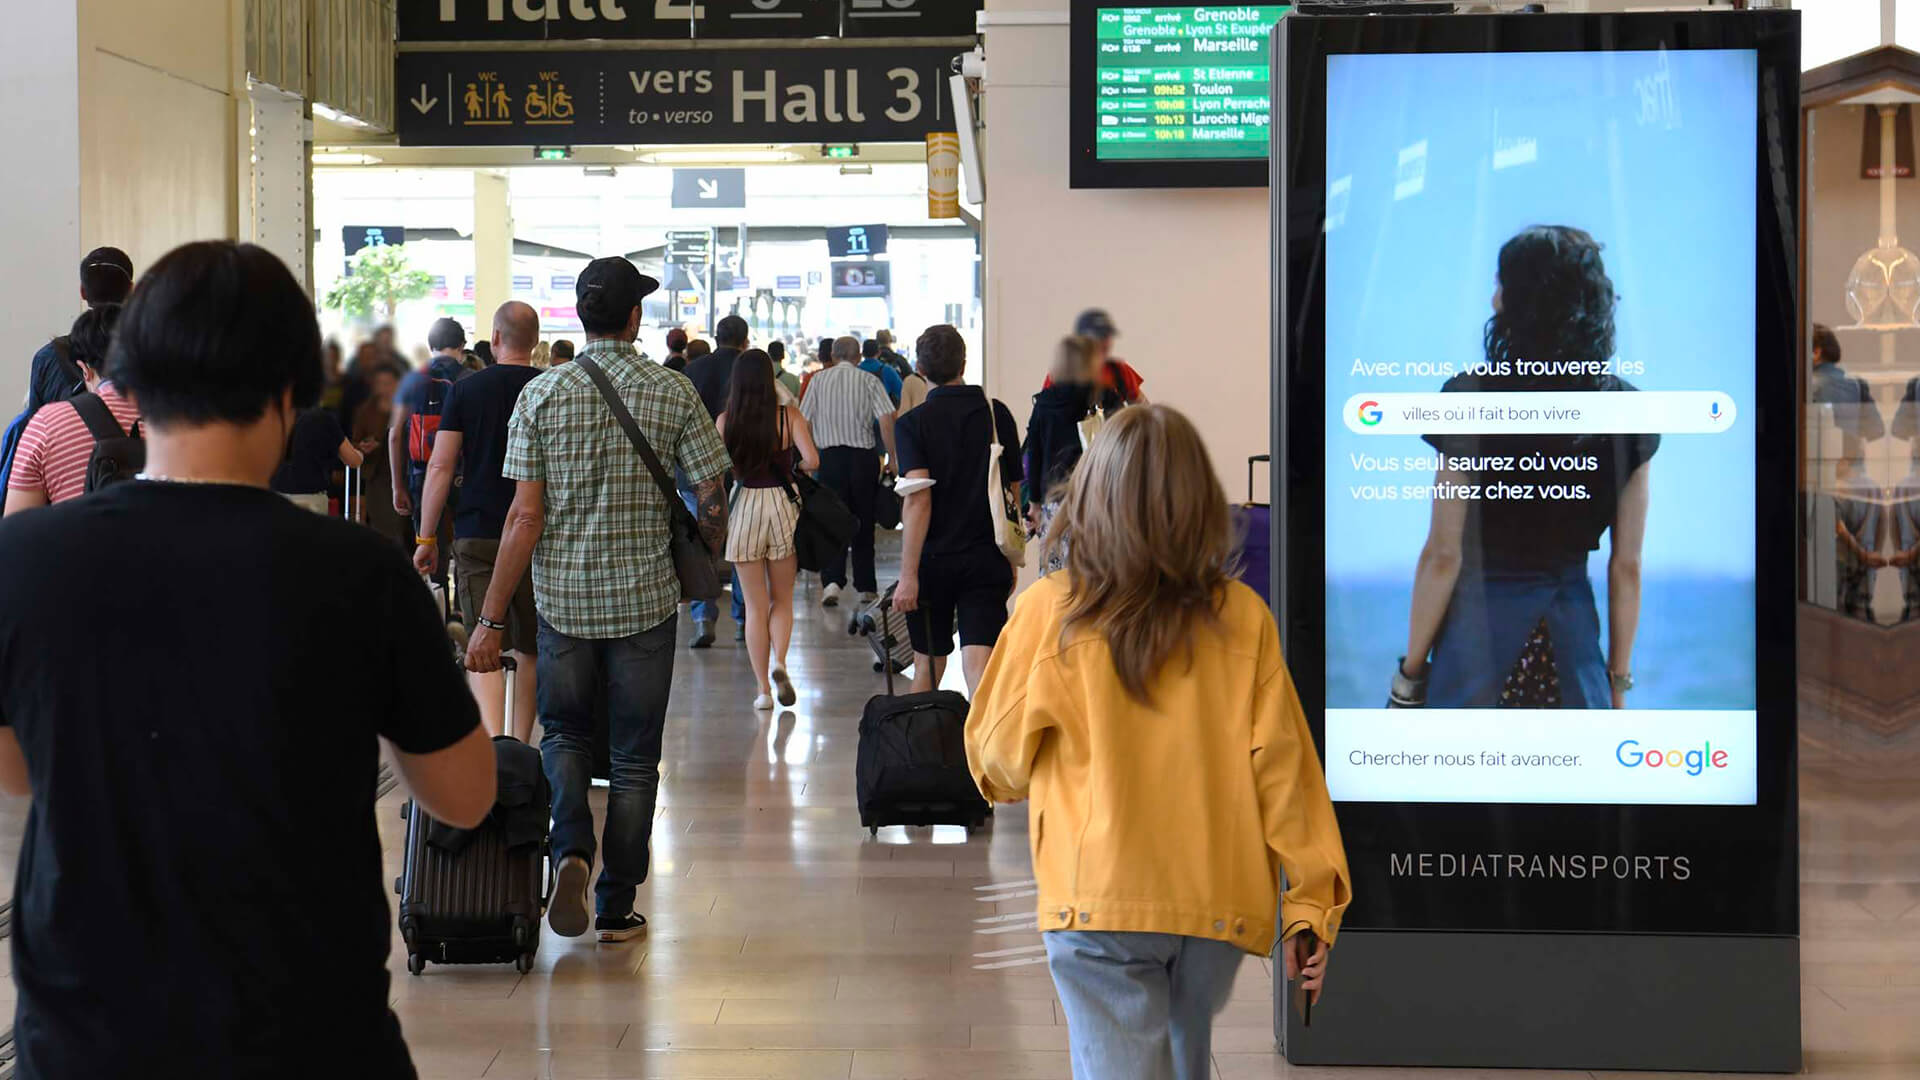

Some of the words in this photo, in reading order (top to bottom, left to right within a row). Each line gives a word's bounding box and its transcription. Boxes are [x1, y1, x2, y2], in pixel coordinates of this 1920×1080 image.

[1194, 7, 1260, 21] Grenoble
[1123, 24, 1176, 36] Grenoble
[1186, 23, 1213, 36] Lyon
[1215, 23, 1229, 35] St
[1194, 37, 1258, 52] Marseille
[478, 72, 498, 81] WC
[539, 72, 559, 81] WC
[1193, 68, 1206, 80] St
[1208, 68, 1254, 80] Etienne
[629, 70, 713, 94] vers
[1193, 83, 1233, 95] Toulon
[732, 68, 866, 124] Hall
[885, 66, 922, 122] 3
[1193, 99, 1221, 112] Lyon
[628, 107, 648, 124] to
[664, 108, 713, 125] verso
[1155, 115, 1185, 125] 10h13
[1193, 114, 1239, 125] Laroche
[1193, 128, 1245, 140] Marseille
[848, 234, 868, 250] 11
[1351, 358, 1401, 376] Avec
[1406, 361, 1458, 379] nous,
[1464, 359, 1511, 376] vous
[1516, 358, 1611, 377] trouverez
[1616, 358, 1645, 375] les
[1403, 408, 1440, 422] villes
[1444, 406, 1464, 421] où
[1468, 407, 1476, 421] il
[1479, 407, 1505, 421] fait
[1508, 407, 1539, 421] bon
[1543, 408, 1581, 421] vivre
[1351, 454, 1399, 472] Vous
[1404, 452, 1444, 471] seul
[1448, 454, 1514, 472] saurez
[1519, 450, 1544, 471] où
[1549, 457, 1598, 471] vous
[1350, 486, 1397, 500] vous
[1402, 481, 1481, 500] sentirez
[1485, 481, 1533, 499] chez
[1537, 484, 1591, 500] vous.
[1349, 750, 1429, 767] Chercher
[1433, 753, 1475, 767] nous
[1480, 750, 1507, 767] fait
[1511, 753, 1583, 767] avancer.
[1616, 740, 1729, 776] Google
[1390, 853, 1692, 881] MEDIATRANSPORTS
